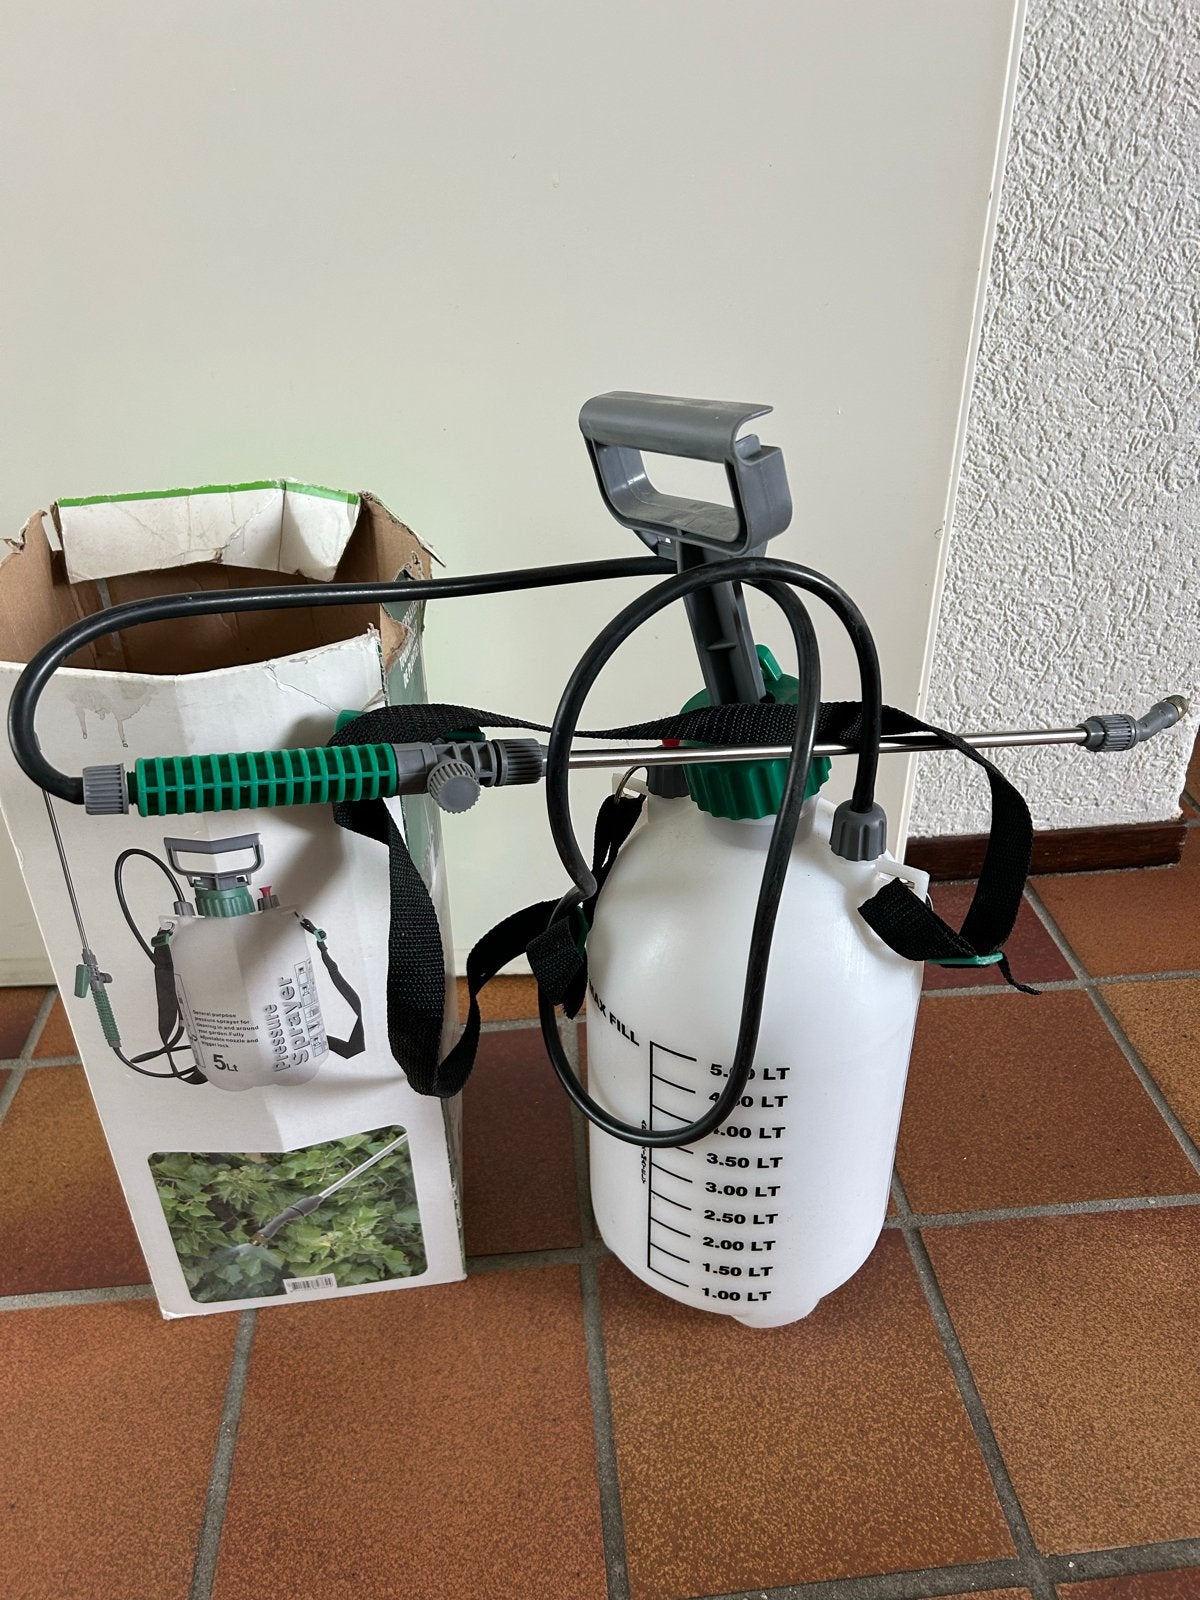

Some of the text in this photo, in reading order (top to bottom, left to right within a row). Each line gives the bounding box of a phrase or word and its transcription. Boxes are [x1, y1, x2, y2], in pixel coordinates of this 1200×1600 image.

[279, 976, 311, 1066] Sprayer
[610, 1011, 640, 1047] FILL
[763, 1067, 790, 1080] LT
[761, 1095, 788, 1108] LT
[759, 1126, 786, 1139] LT
[706, 1152, 783, 1168] 3.50 LT
[705, 1181, 781, 1197] 3.00 LT
[703, 1209, 779, 1225] 2.50 LT
[702, 1236, 776, 1251] 2.00 LT
[702, 1262, 773, 1277] 1.50 LT
[701, 1287, 772, 1302] 1.00 LT
